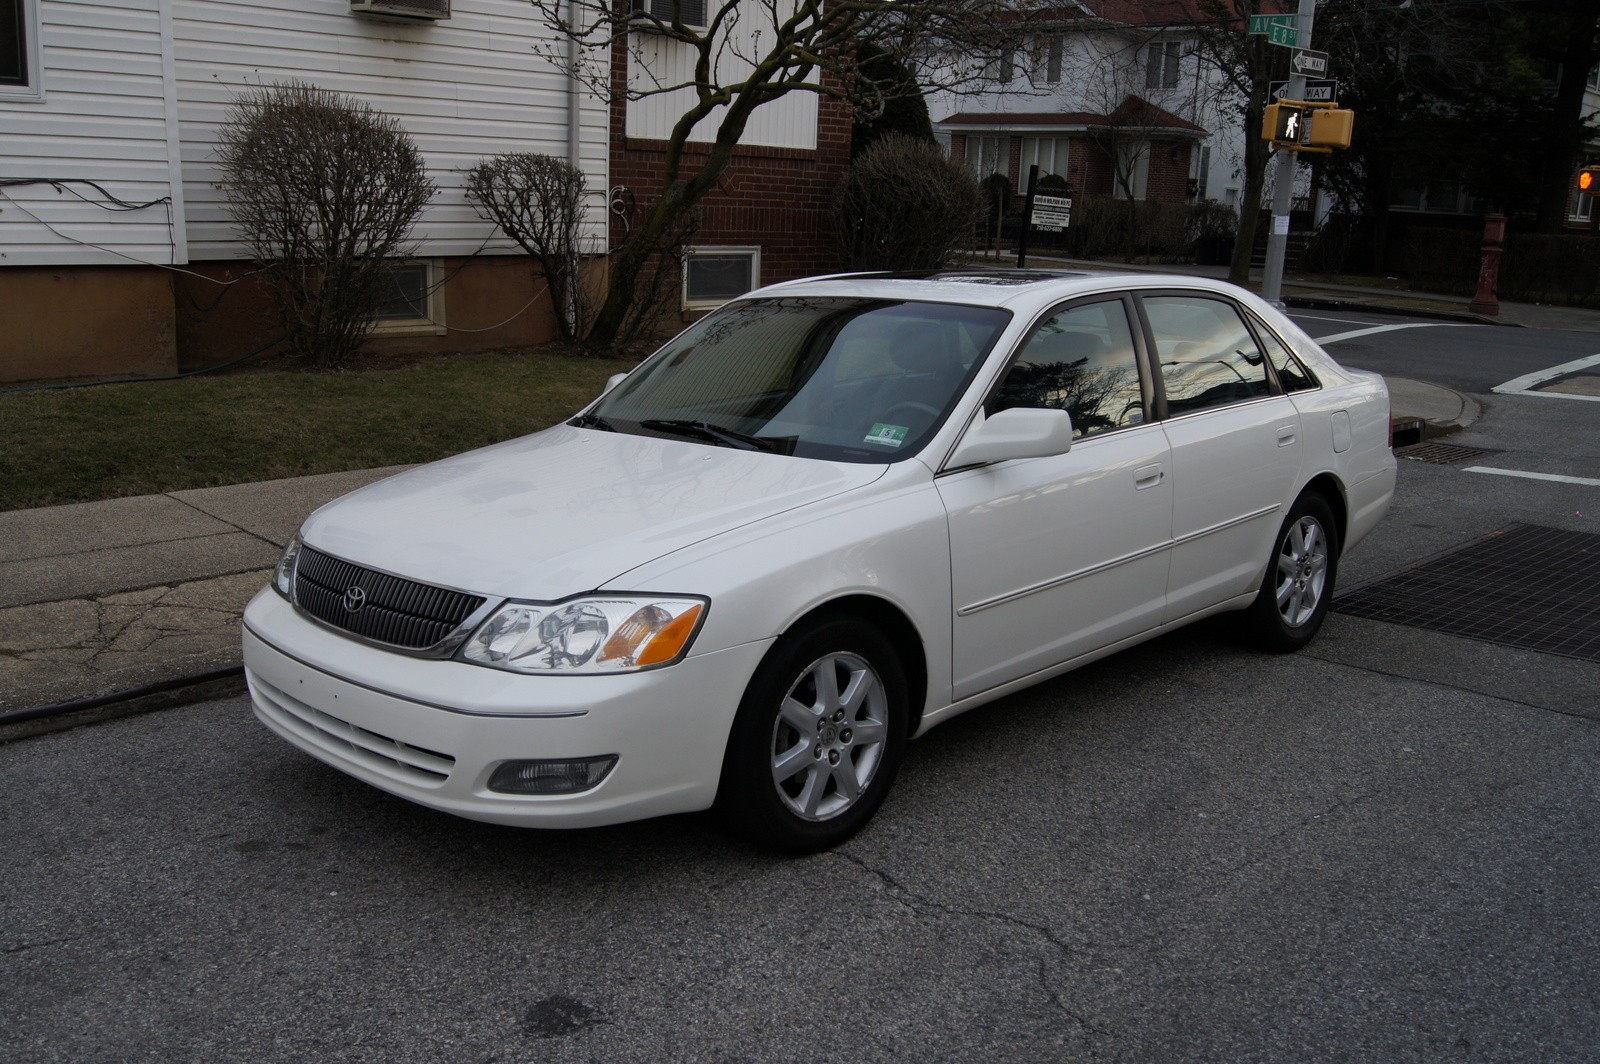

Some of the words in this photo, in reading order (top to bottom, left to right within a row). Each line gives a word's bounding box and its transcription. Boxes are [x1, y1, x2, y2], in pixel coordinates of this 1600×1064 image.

[1273, 27, 1279, 42] E
[1281, 29, 1287, 44] 8
[1297, 56, 1307, 67] ONE
[1311, 60, 1323, 69] WAY
[1306, 88, 1327, 98] WAY
[884, 429, 891, 437] 5
